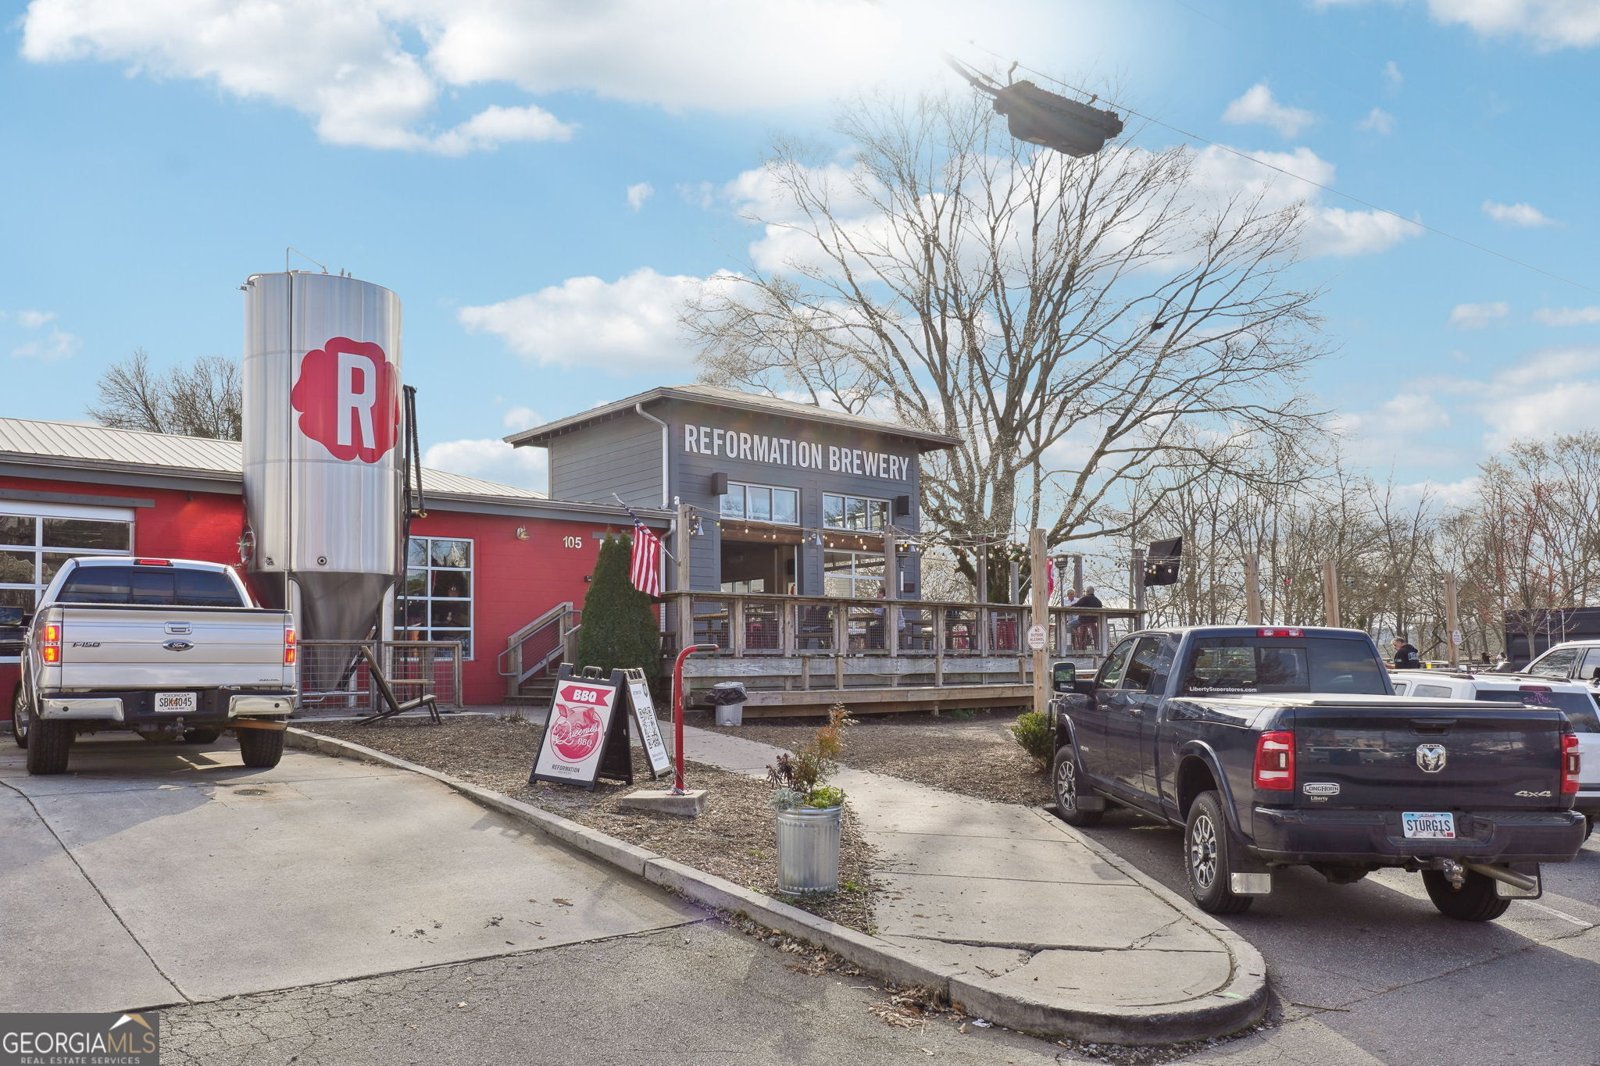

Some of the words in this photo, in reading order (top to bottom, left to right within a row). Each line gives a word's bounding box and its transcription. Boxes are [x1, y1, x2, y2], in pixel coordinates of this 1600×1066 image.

[337, 351, 377, 450] R
[684, 423, 823, 470] REFORMATION
[829, 445, 910, 481] BREWERY
[562, 535, 583, 549] 105
[159, 697, 193, 707] SBK4045
[573, 689, 597, 702] BBQ
[577, 738, 593, 747] BBQ
[551, 763, 581, 773] REFORMATION
[1406, 819, 1451, 832] STURG1S
